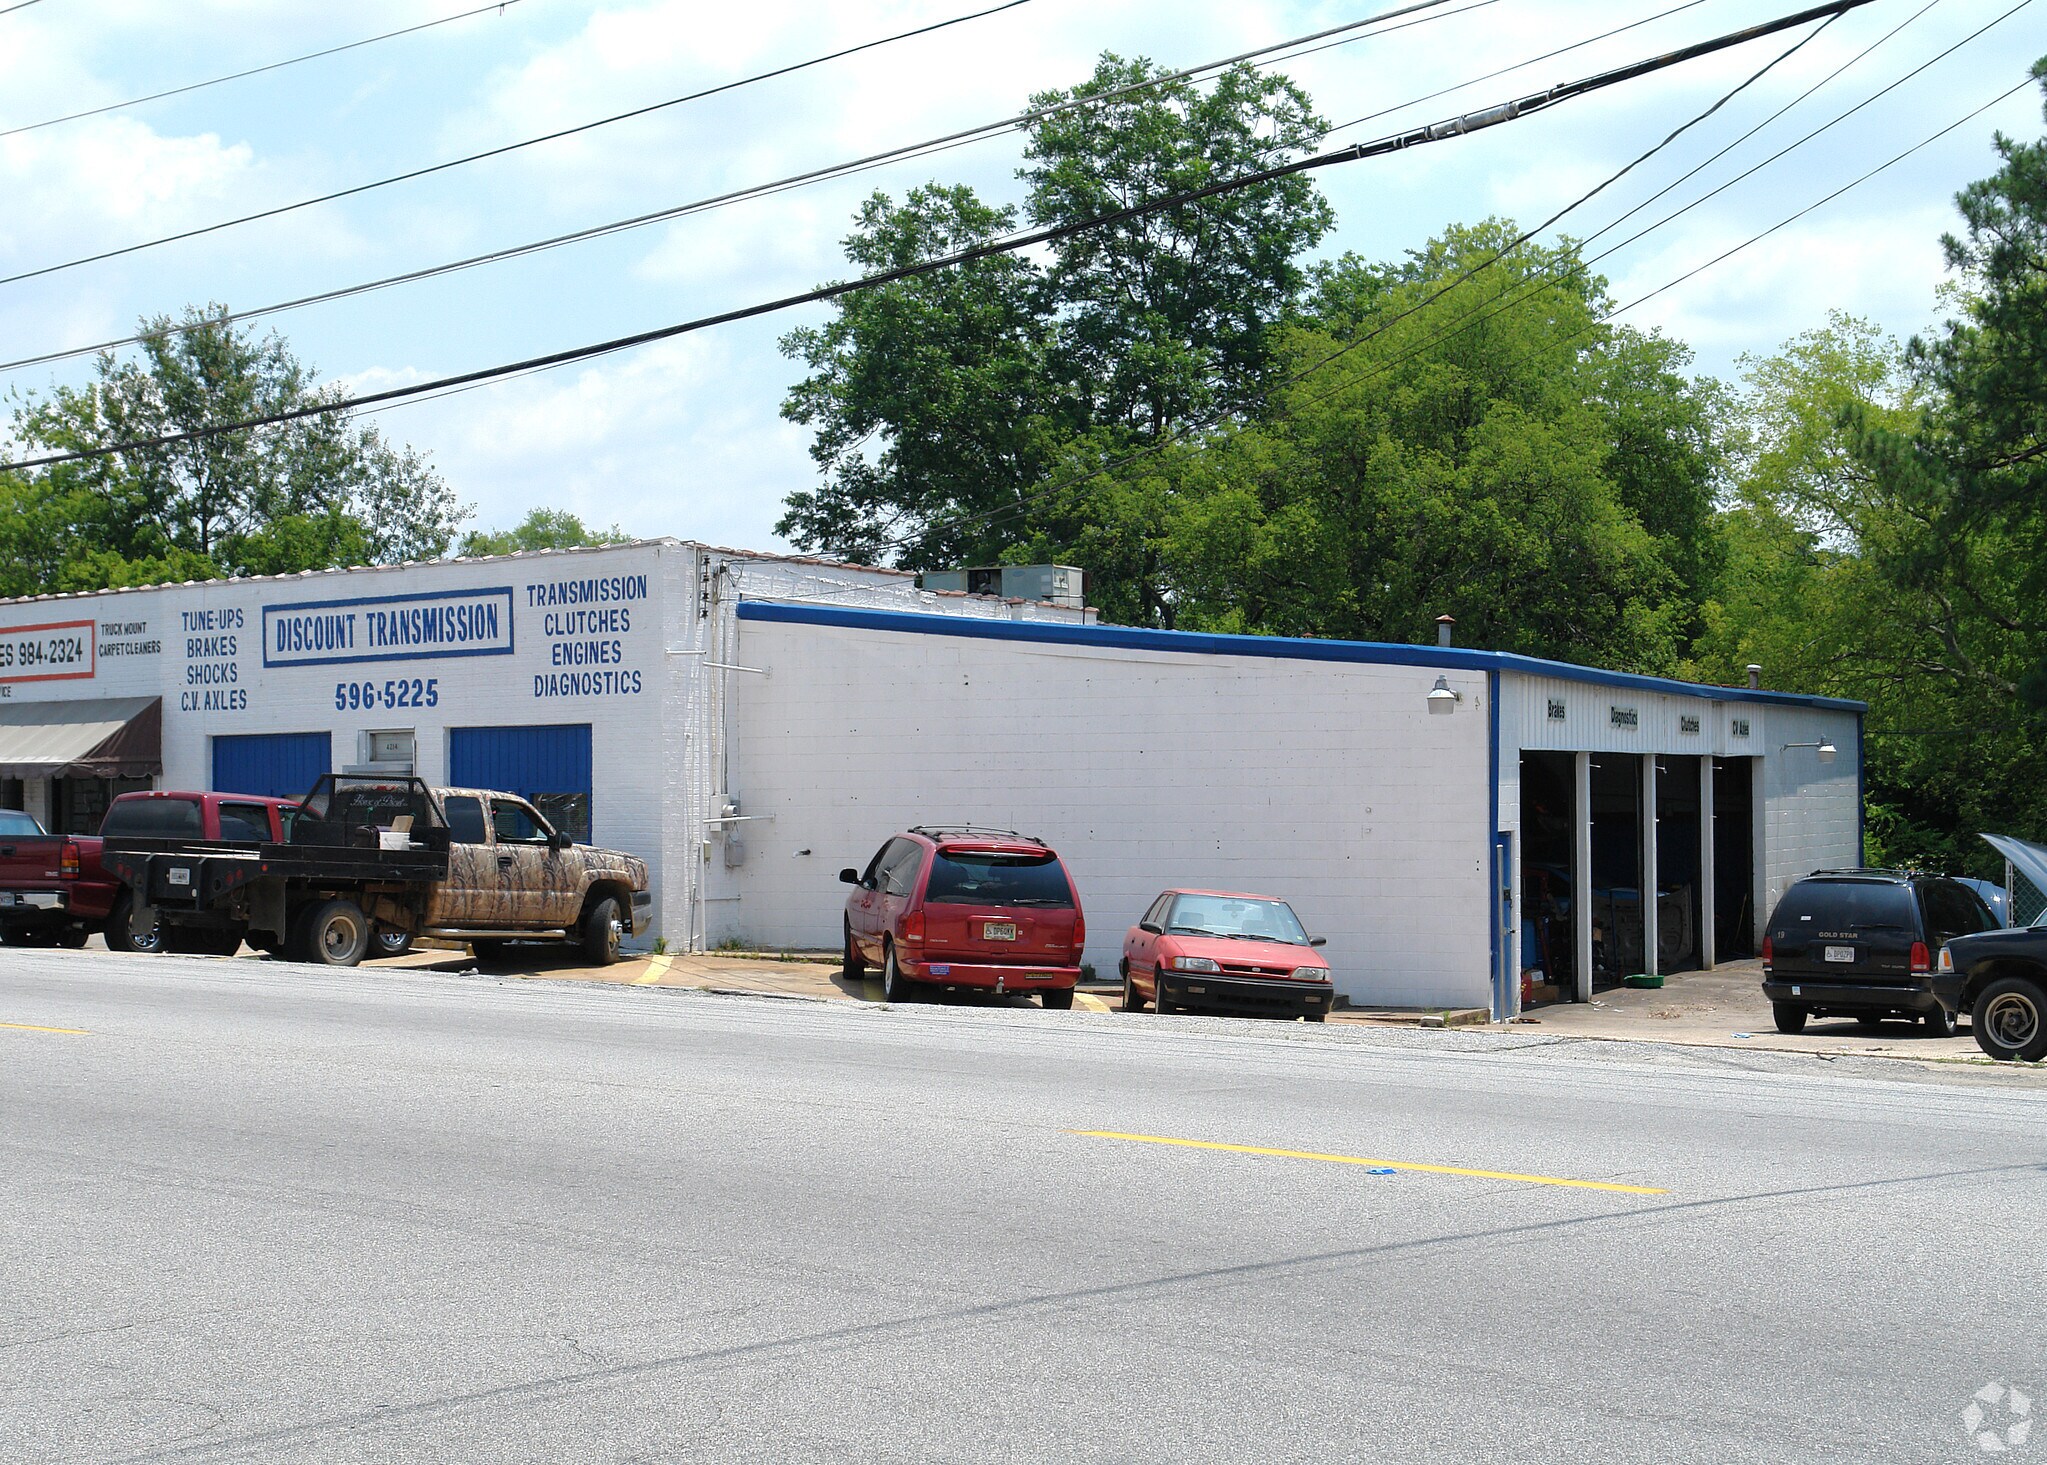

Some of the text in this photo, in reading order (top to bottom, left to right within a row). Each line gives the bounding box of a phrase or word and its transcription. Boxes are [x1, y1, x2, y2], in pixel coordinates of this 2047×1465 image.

[527, 575, 647, 607] TRANSMISSION
[101, 622, 147, 636] TRUCK MOUNT
[182, 608, 244, 631] TUNE-UPS
[277, 603, 498, 652] DISCOUNT TRANSMISSION
[545, 608, 630, 636] CLUTCHES
[99, 640, 161, 657] CARPET CLEANERS
[187, 636, 237, 658] BRAKES
[552, 640, 622, 666] ENGINES
[187, 663, 238, 685] SHOCKS
[534, 670, 642, 697] DIAGNOSTICS
[0, 686, 11, 698] ICE
[181, 689, 247, 711] C.V. AXLES
[1548, 700, 1565, 718] Brakes
[1611, 707, 1637, 727] Diagnostics
[1732, 721, 1738, 735] CV
